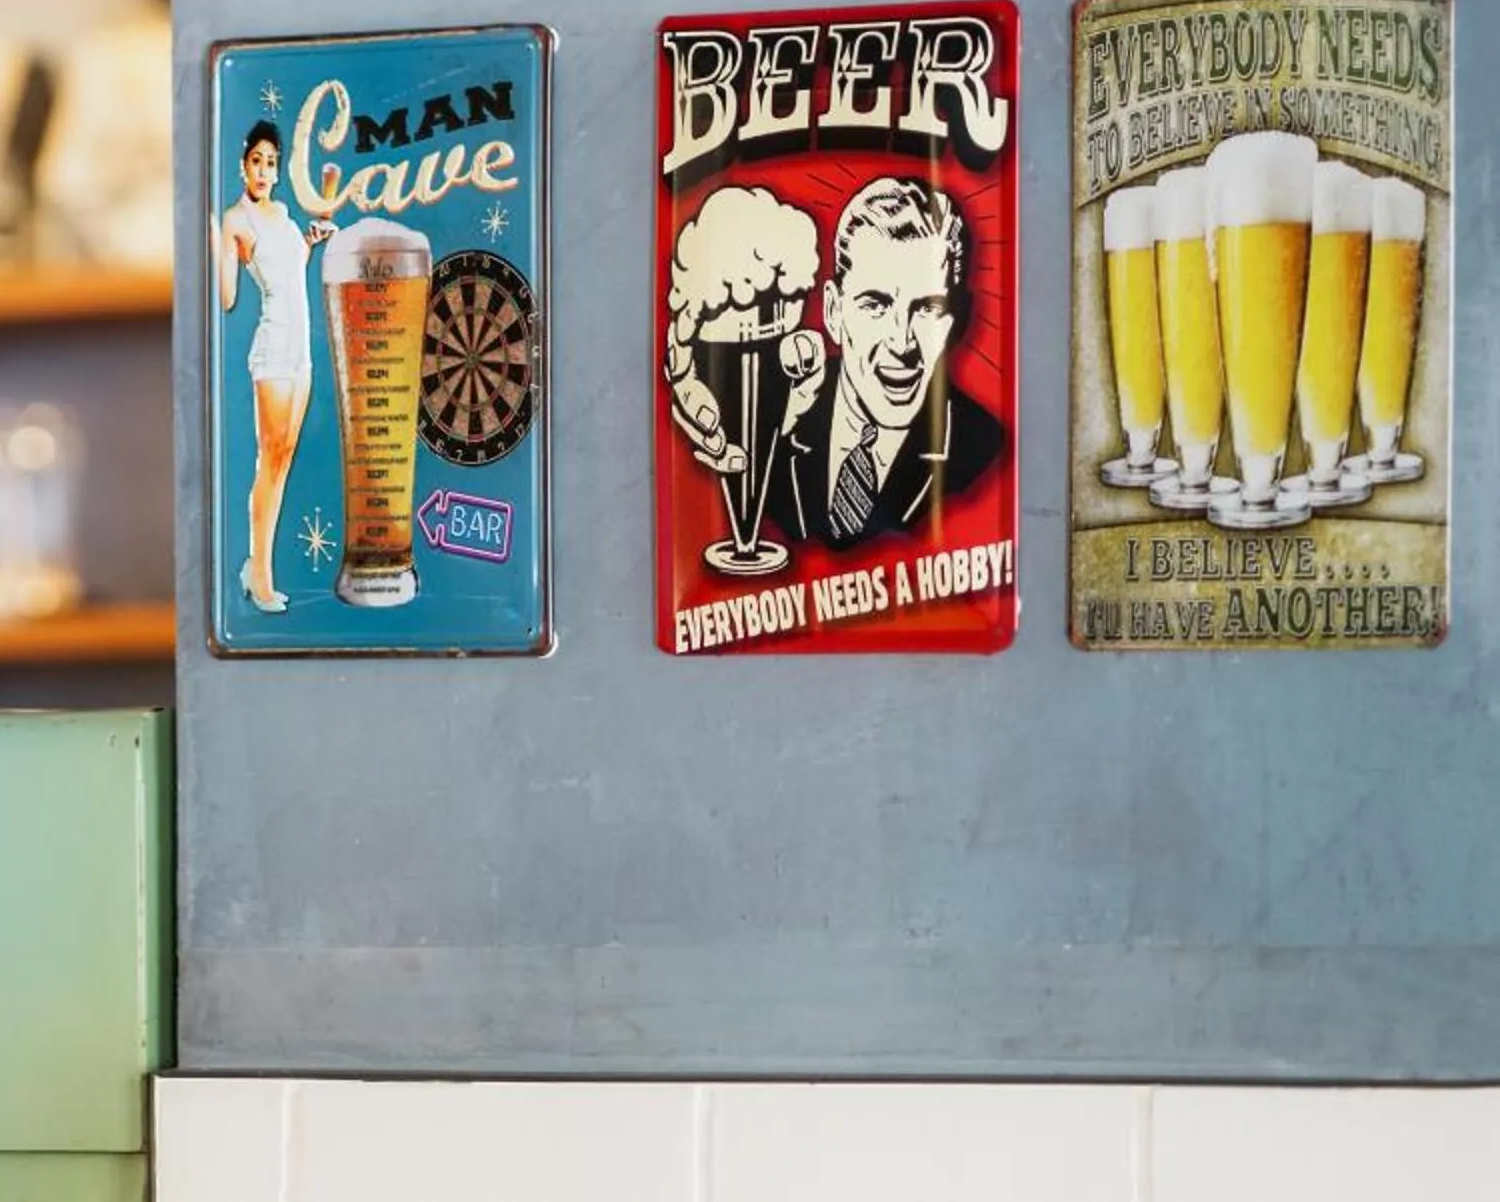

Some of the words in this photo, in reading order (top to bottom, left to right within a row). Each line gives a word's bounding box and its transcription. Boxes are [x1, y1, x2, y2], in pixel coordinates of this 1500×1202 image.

[353, 81, 515, 153] MAN
[663, 16, 1008, 175] BEER
[1087, 8, 1305, 123] EVERYBODY
[1314, 6, 1444, 105] NEEDS
[288, 79, 519, 215] Cave
[1087, 121, 1124, 193] TO
[1129, 88, 1238, 164] BELIEVE
[1244, 86, 1274, 130] IN
[1279, 85, 1443, 182] SOMETHING
[451, 505, 502, 545] BAR
[1125, 538, 1140, 582] I
[675, 584, 805, 654] EVERYBODY
[812, 566, 889, 623] NEEDS
[895, 561, 913, 606] A
[916, 539, 1013, 601] HOBBY!
[1129, 599, 1214, 640] HAVE
[1221, 585, 1443, 639] ANOTHER!
